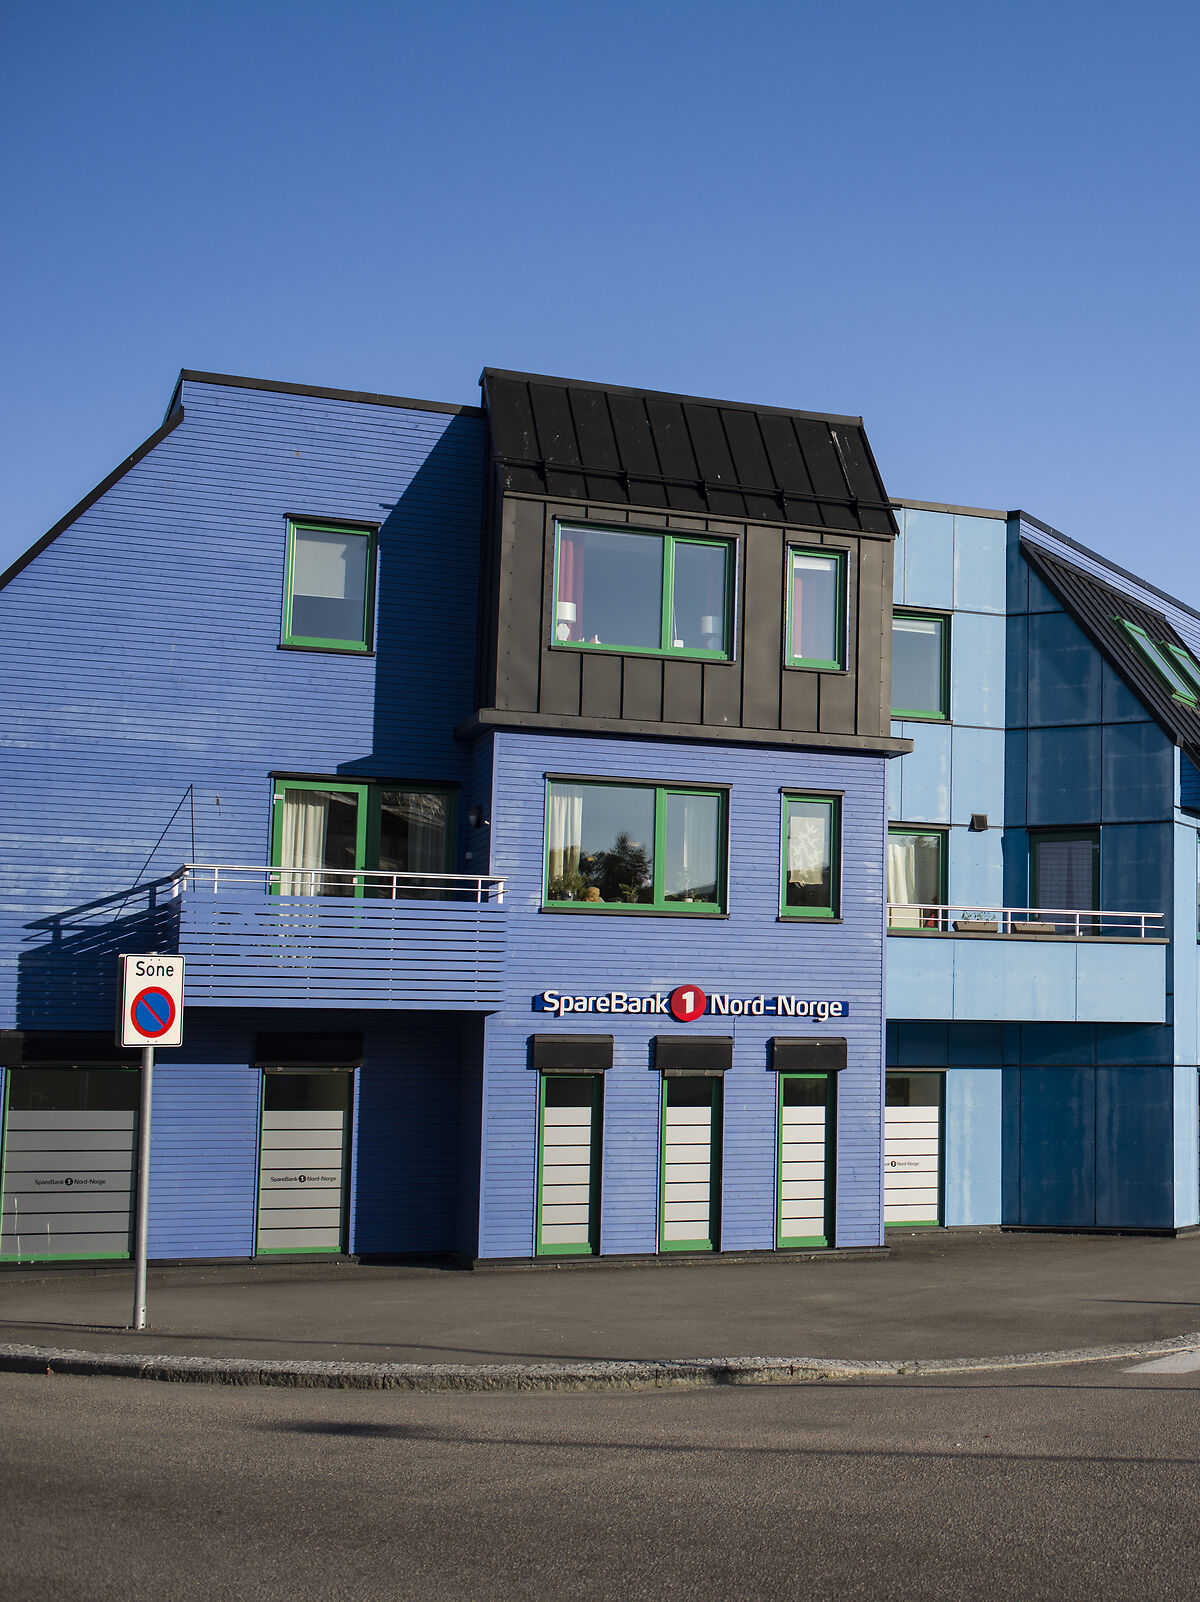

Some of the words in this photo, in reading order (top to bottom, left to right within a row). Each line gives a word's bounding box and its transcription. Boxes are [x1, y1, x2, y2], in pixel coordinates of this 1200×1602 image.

[135, 960, 175, 978] Sone
[542, 989, 670, 1017] SpareBank
[710, 993, 843, 1022] Nord-Norge
[74, 1178, 106, 1186] Nord-Norge
